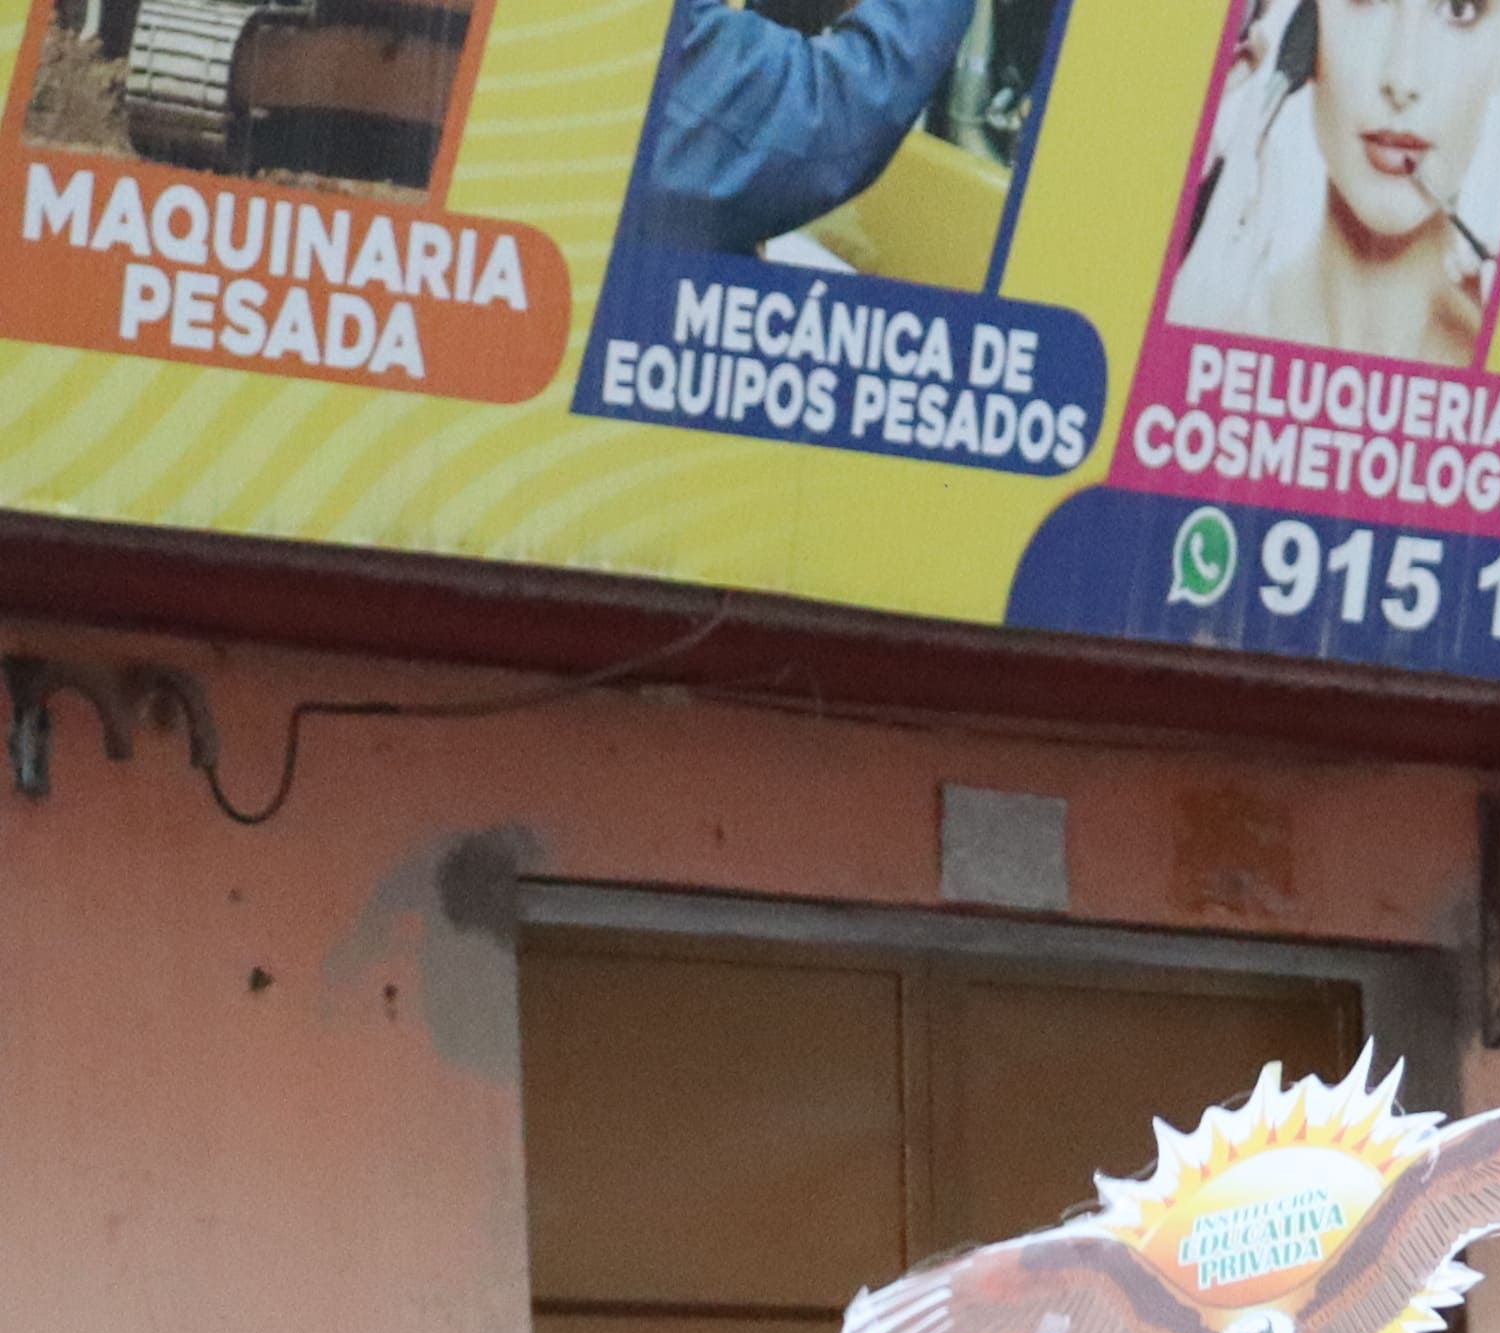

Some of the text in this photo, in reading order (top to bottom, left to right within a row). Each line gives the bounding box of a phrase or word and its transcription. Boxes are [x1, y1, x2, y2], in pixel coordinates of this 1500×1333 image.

[21, 161, 528, 312] MAQUINARIA
[119, 262, 426, 380] PESADA
[673, 278, 1039, 393] MECÁNICA DE
[602, 339, 1088, 470] EQUIPOS PESADOS
[1257, 522, 1446, 631] 915
[1200, 1235, 1321, 1288] PRIVADA
